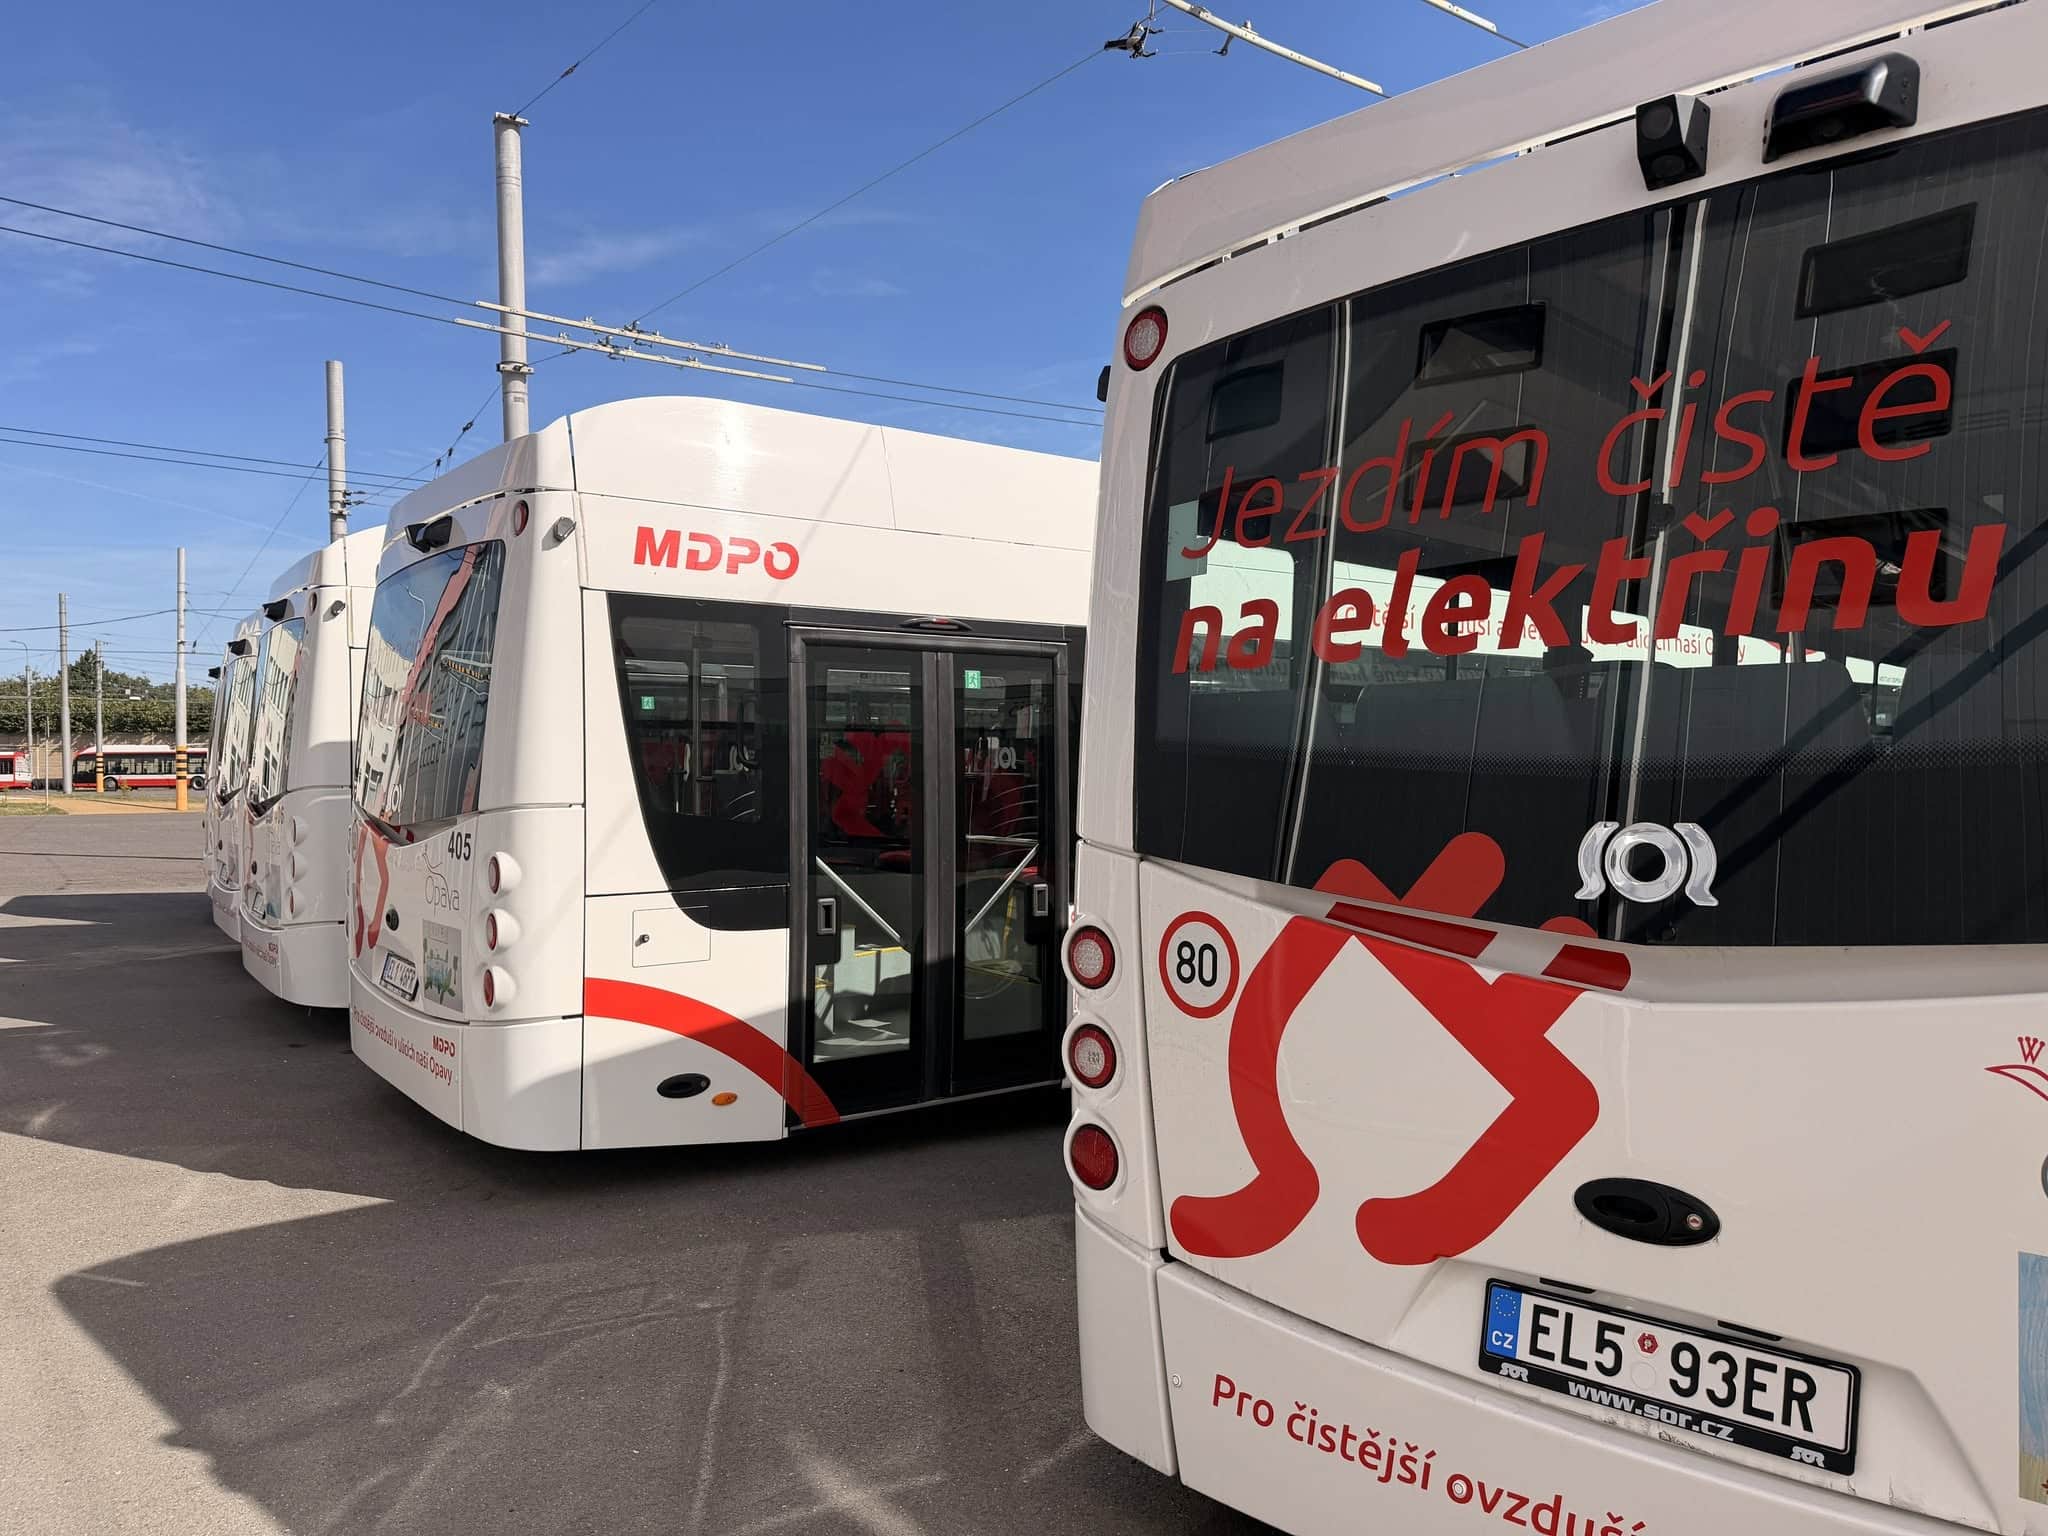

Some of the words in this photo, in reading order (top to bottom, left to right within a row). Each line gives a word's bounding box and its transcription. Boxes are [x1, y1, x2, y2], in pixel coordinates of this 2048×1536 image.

[1181, 410, 1550, 559] Jezdím
[1596, 319, 1952, 496] čistě
[633, 525, 801, 580] MDPO
[1172, 597, 1280, 674] na
[1312, 507, 2007, 664] elektřinu
[447, 831, 472, 861] 405
[425, 875, 461, 917] Opava
[1176, 940, 1218, 988] 80
[432, 1035, 456, 1058] MDPO
[430, 1056, 453, 1087] Opavy
[1491, 1330, 1513, 1350] CZ
[1499, 1361, 1529, 1383] SOR
[1529, 1303, 1626, 1377] EL5
[1668, 1341, 1818, 1434] 93ER
[1212, 1374, 1275, 1427] Pro
[1286, 1400, 1438, 1491] čistější
[1567, 1380, 1735, 1442] www.sor.cz
[1790, 1446, 1825, 1468] SOR
